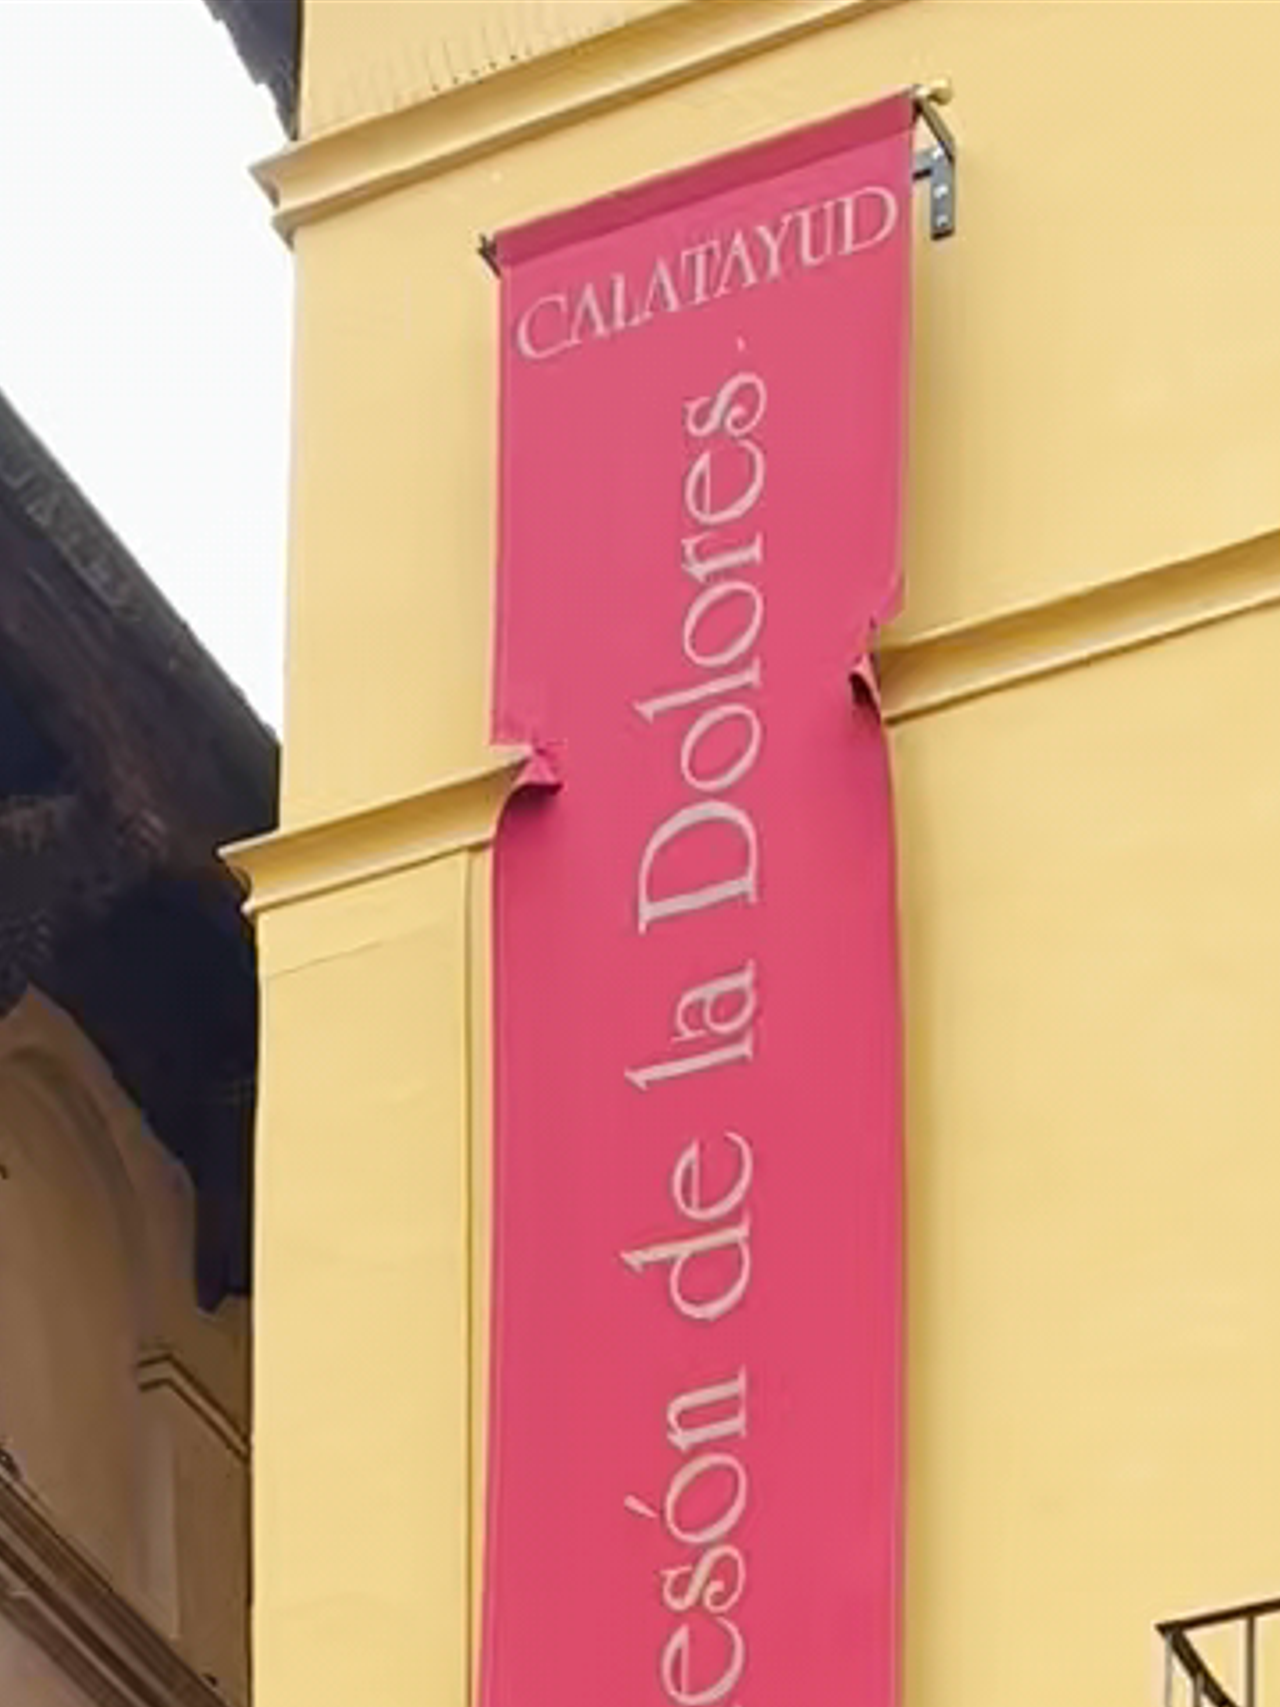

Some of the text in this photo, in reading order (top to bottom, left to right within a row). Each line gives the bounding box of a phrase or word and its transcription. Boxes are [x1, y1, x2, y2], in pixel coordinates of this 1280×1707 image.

[516, 185, 899, 360] CALATAYUD
[632, 371, 768, 936] Dolores
[624, 958, 757, 1091] la
[619, 1129, 754, 1322] de
